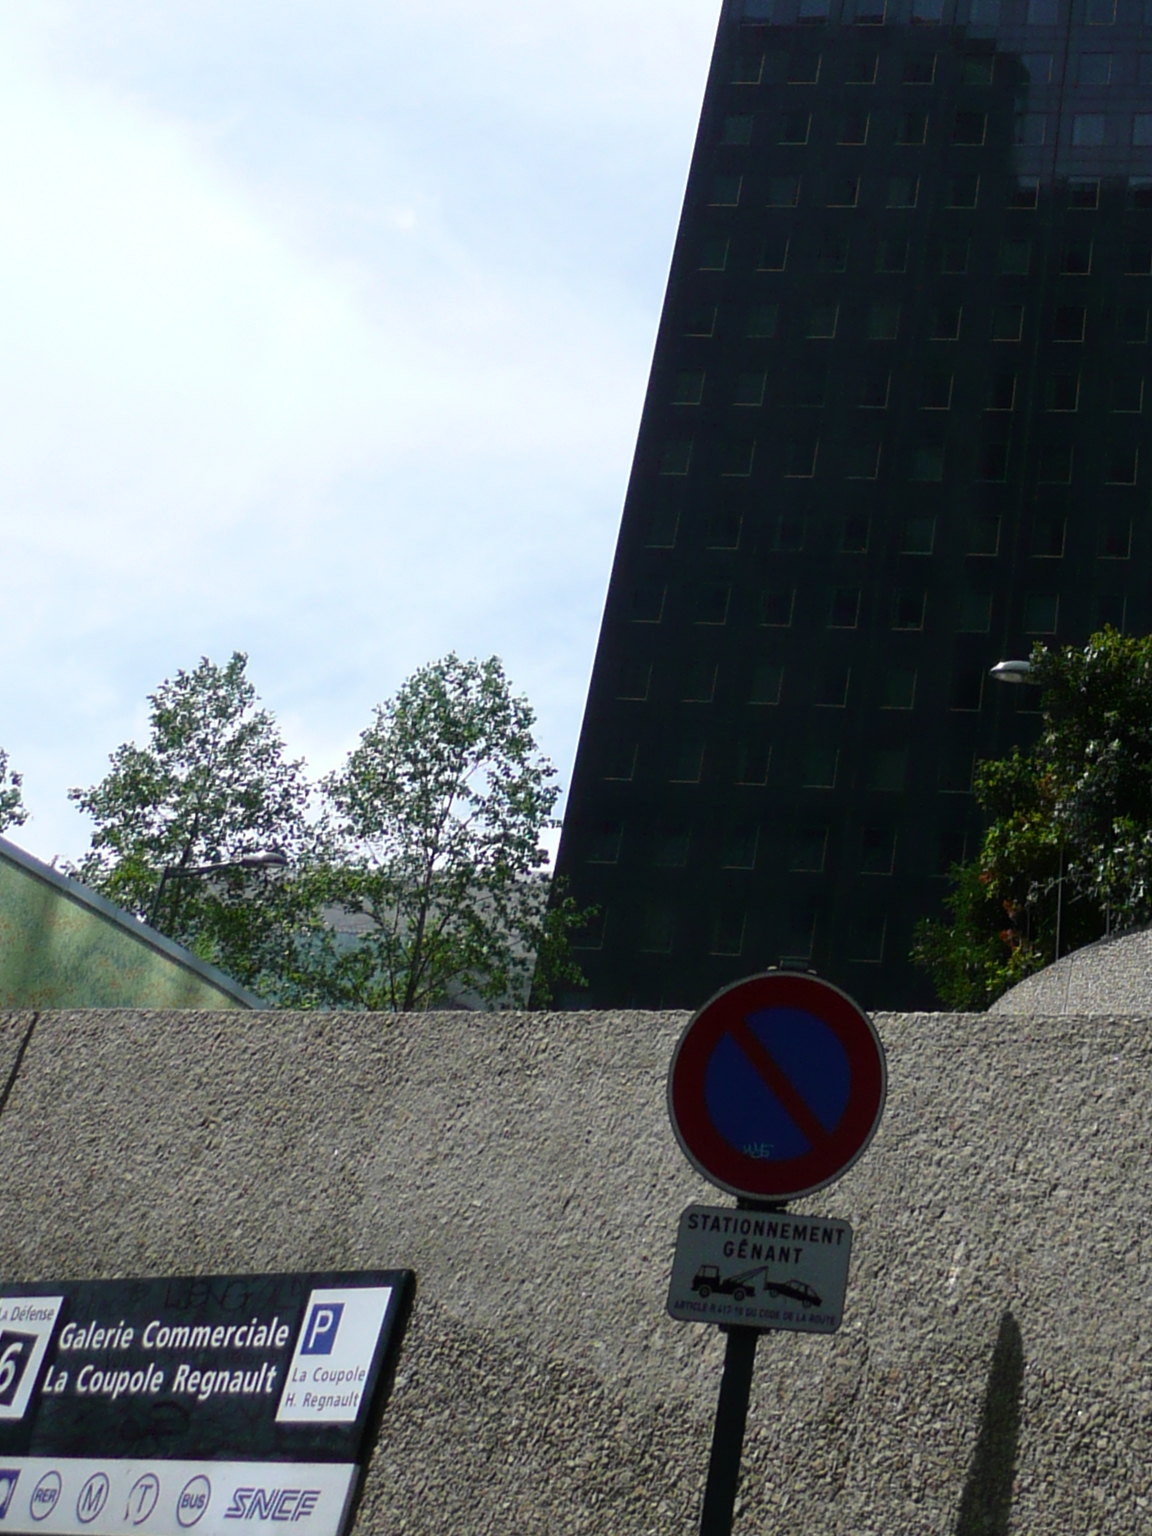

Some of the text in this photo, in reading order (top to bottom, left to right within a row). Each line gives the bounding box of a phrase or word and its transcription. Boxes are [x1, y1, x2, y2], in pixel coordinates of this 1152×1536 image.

[688, 1213, 845, 1245] STATIONNEMENT
[723, 1239, 803, 1264] GÊNANT
[10, 1305, 55, 1322] Défense
[674, 1300, 707, 1313] ARTICLE
[745, 1308, 756, 1318] DU
[758, 1309, 781, 1320] CODE
[783, 1312, 794, 1322] DE
[795, 1313, 807, 1323] LA
[808, 1313, 836, 1326] ROUTE
[59, 1316, 289, 1351] Galerie Commerciale
[308, 1310, 333, 1349] P
[0, 1342, 24, 1393] 6
[42, 1362, 277, 1400] La Coupole Regnault
[292, 1367, 365, 1384] La Coupole
[285, 1391, 360, 1409] H. Regnault
[34, 1488, 57, 1503] RER
[81, 1483, 104, 1511] M
[137, 1484, 153, 1513] T
[181, 1493, 206, 1508] BUS
[224, 1487, 321, 1521] SNCF
